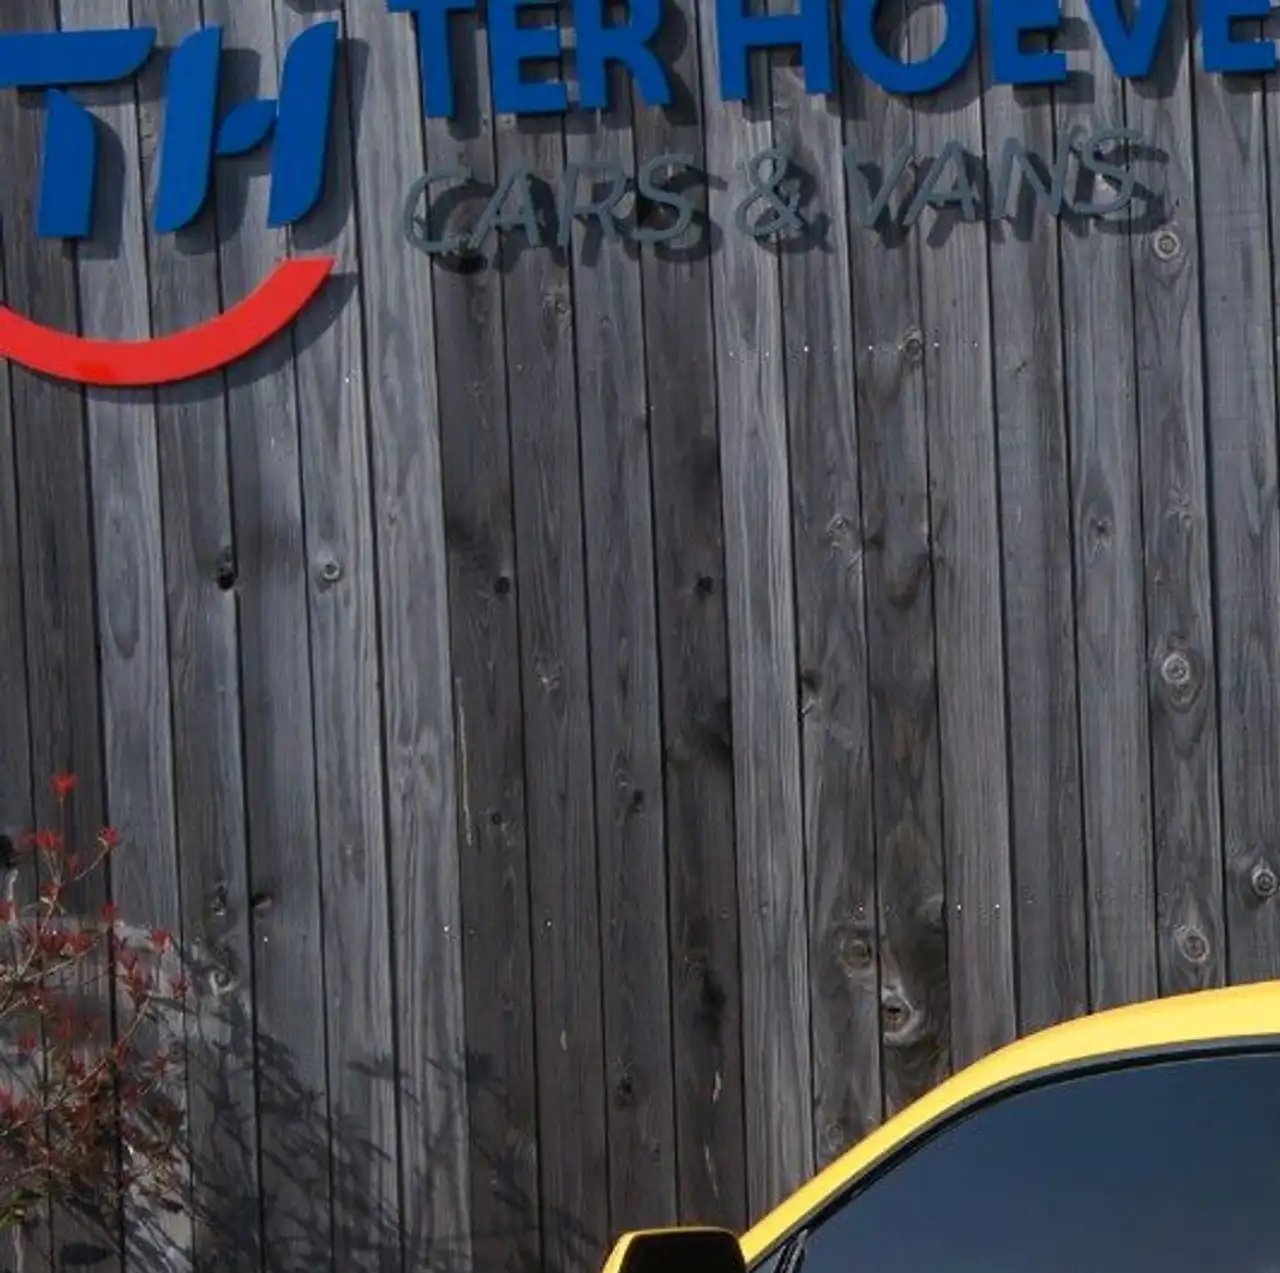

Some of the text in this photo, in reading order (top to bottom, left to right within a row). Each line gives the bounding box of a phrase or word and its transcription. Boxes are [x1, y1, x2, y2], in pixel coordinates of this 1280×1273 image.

[388, 0, 672, 118] TER
[403, 126, 1146, 254] CARS & VANS
